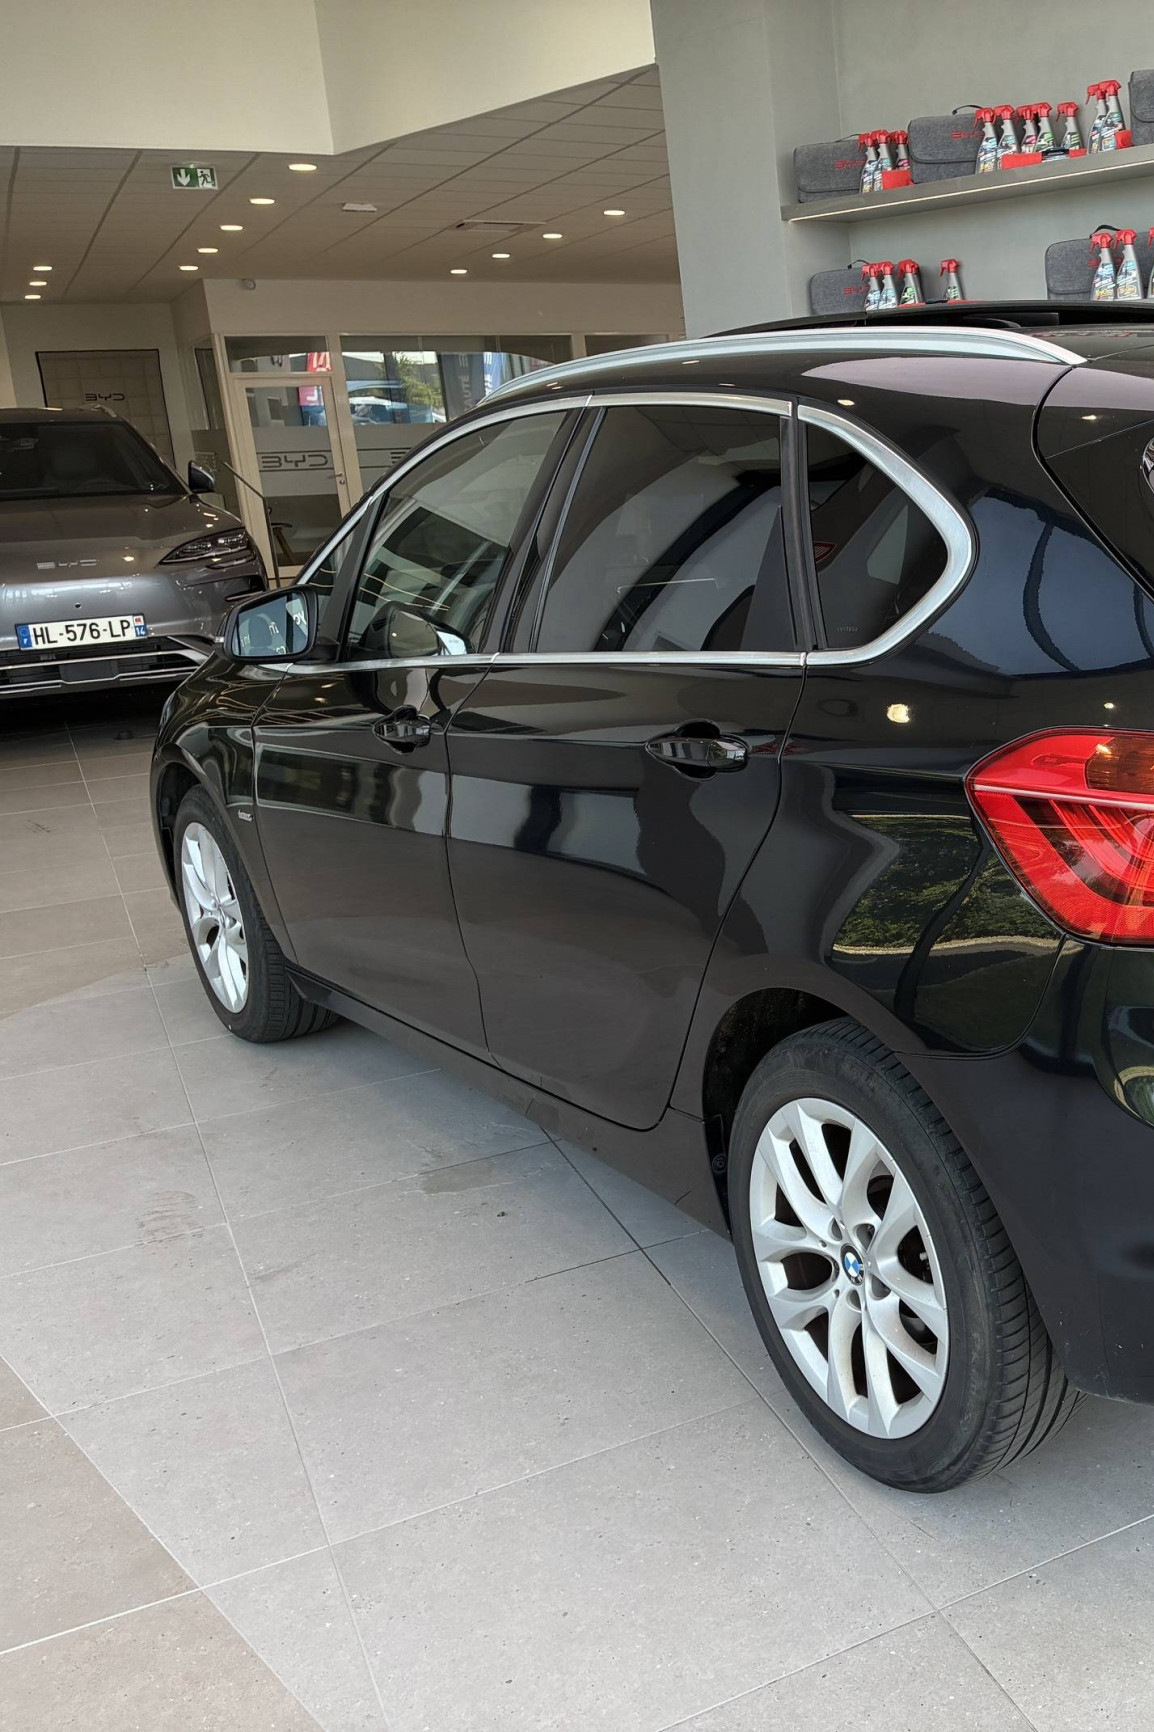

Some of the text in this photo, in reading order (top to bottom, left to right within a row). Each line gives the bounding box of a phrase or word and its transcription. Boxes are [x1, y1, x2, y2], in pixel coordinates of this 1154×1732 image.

[84, 393, 125, 401] BYD
[261, 454, 328, 468] BYD
[33, 619, 131, 645] HL-576-LP
[135, 626, 146, 636] 14
